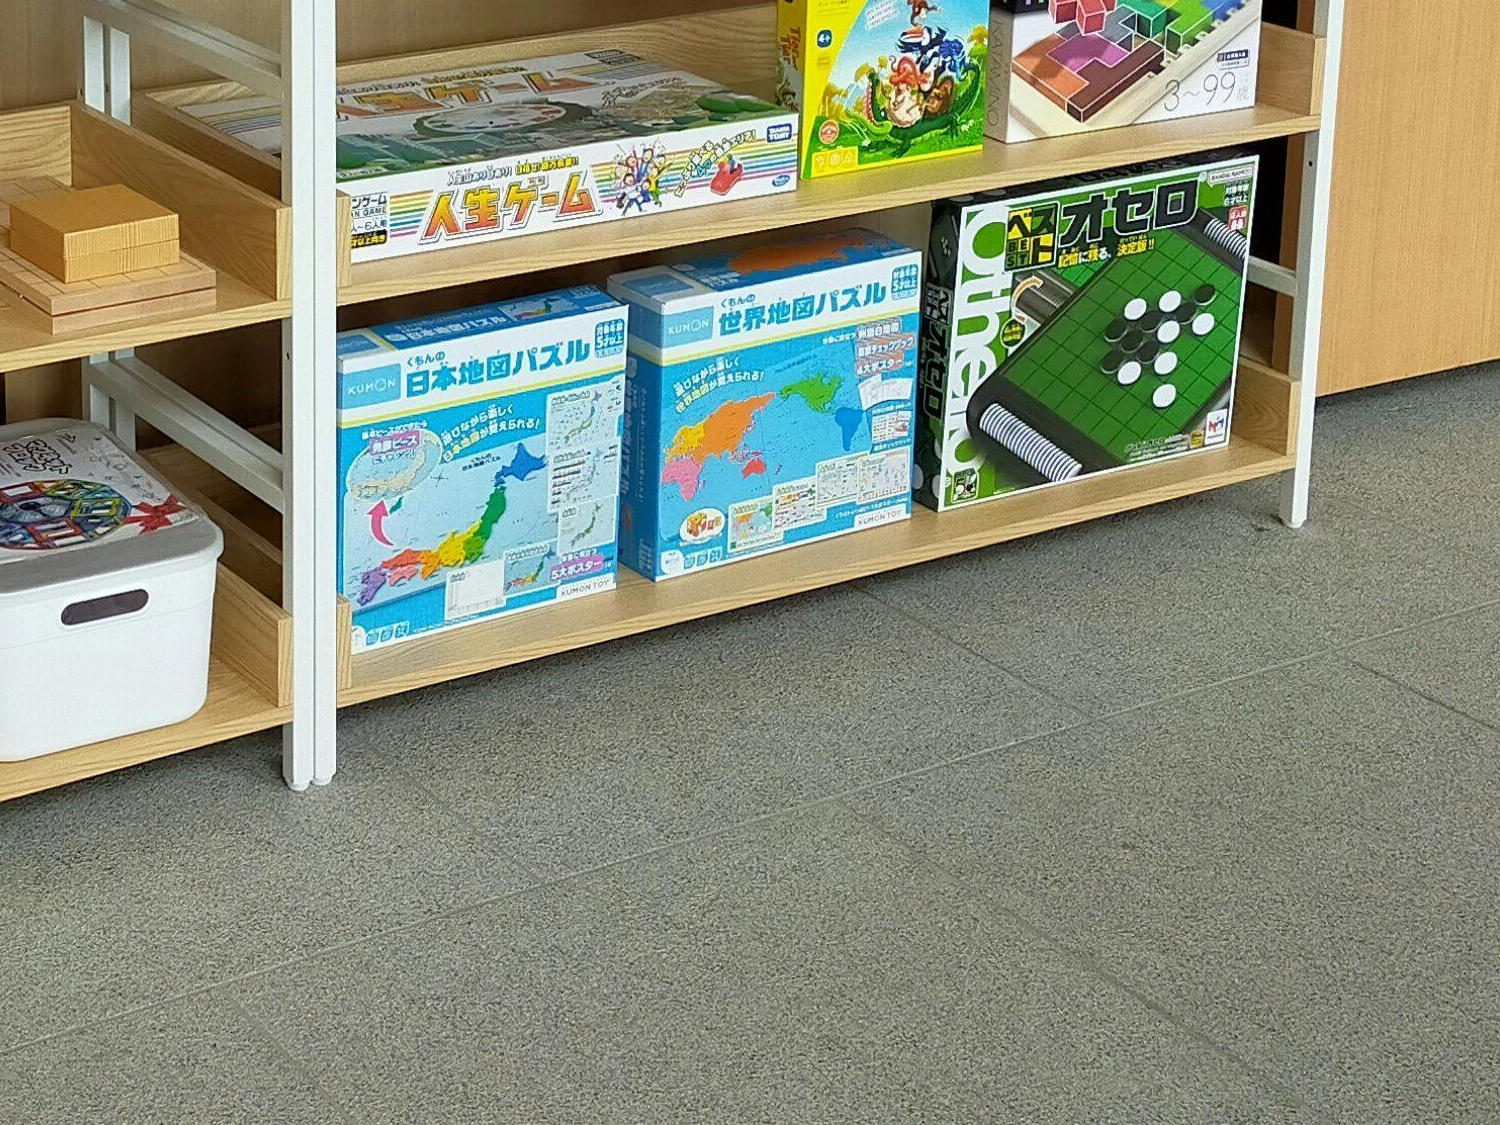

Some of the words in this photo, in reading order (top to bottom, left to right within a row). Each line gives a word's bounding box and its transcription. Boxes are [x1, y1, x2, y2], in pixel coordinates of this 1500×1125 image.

[818, 34, 831, 44] 4+
[768, 132, 790, 141] TOMY
[1211, 172, 1231, 182] BANDAI
[1231, 169, 1252, 178] NAMCO
[421, 172, 599, 242] 人生ゲーム
[1058, 180, 1199, 248] オセロ
[718, 282, 887, 336] 世界地図パズル
[720, 293, 756, 309] くもんの
[668, 318, 709, 336] KUMON
[407, 351, 445, 366] くもんの
[406, 339, 591, 398] 日本地図パズル
[347, 377, 396, 396] KUMON
[857, 514, 882, 526] KUMON
[561, 584, 591, 596] KUMON
